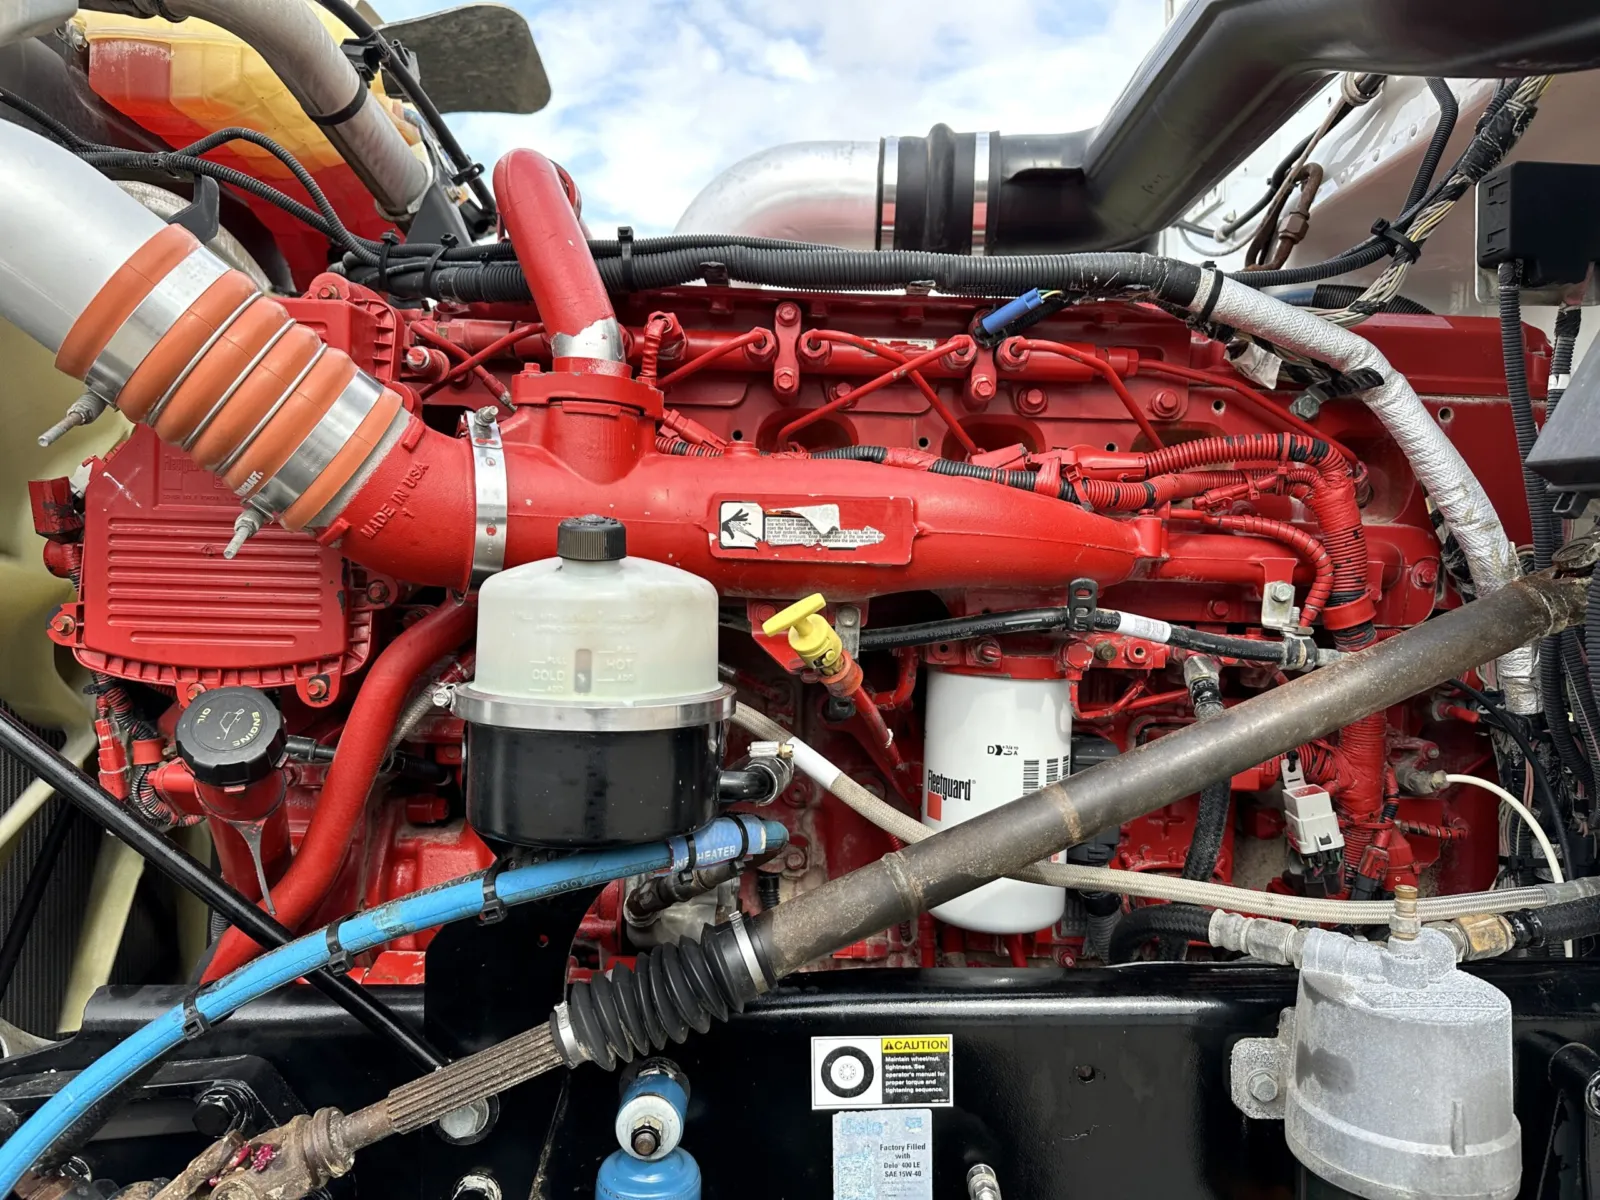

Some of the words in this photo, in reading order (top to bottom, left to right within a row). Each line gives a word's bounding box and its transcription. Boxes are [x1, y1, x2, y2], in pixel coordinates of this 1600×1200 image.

[360, 503, 396, 540] MADE
[391, 488, 410, 506] IN
[402, 460, 430, 488] USA
[606, 658, 634, 670] HOT
[532, 668, 566, 682] COLD
[197, 708, 212, 724] OIL
[232, 711, 260, 746] ENGINE
[928, 769, 970, 801] Fleetguard
[696, 844, 736, 862] HEATER
[894, 1040, 948, 1050] CAUTION
[880, 1144, 905, 1152] Factory
